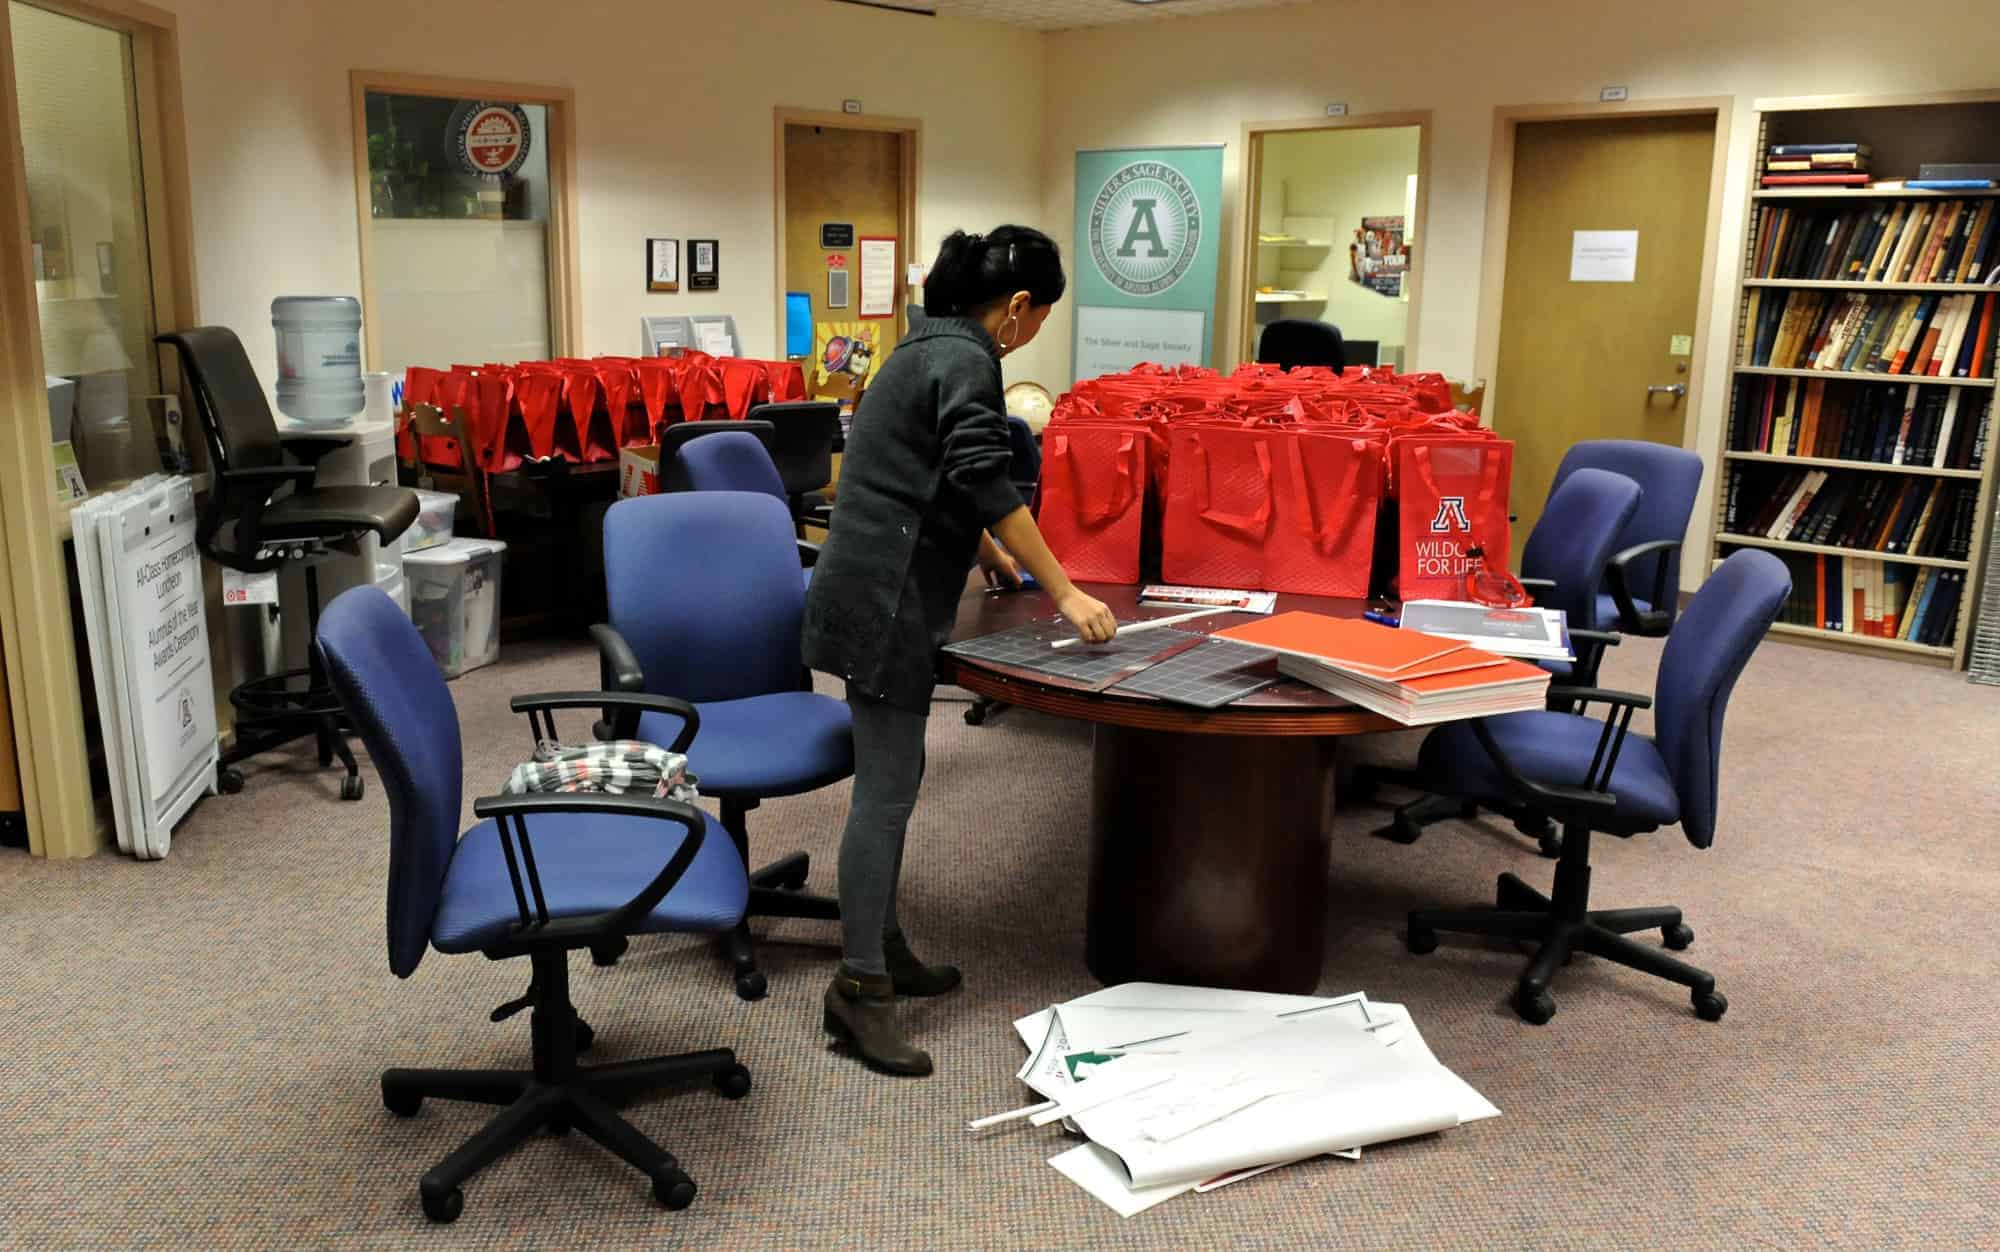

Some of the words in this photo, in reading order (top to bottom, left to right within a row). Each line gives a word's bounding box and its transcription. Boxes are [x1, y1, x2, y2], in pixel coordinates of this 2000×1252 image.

[1093, 177, 1121, 217] SILVER
[1121, 170, 1131, 182] &
[1132, 164, 1162, 178] SAGE
[1164, 169, 1200, 217] SOCIETY
[1116, 198, 1169, 258] A
[1431, 496, 1470, 533] A
[1415, 541, 1486, 558] WILDC
[1418, 558, 1450, 576] FOR
[1454, 557, 1484, 576] LIFE
